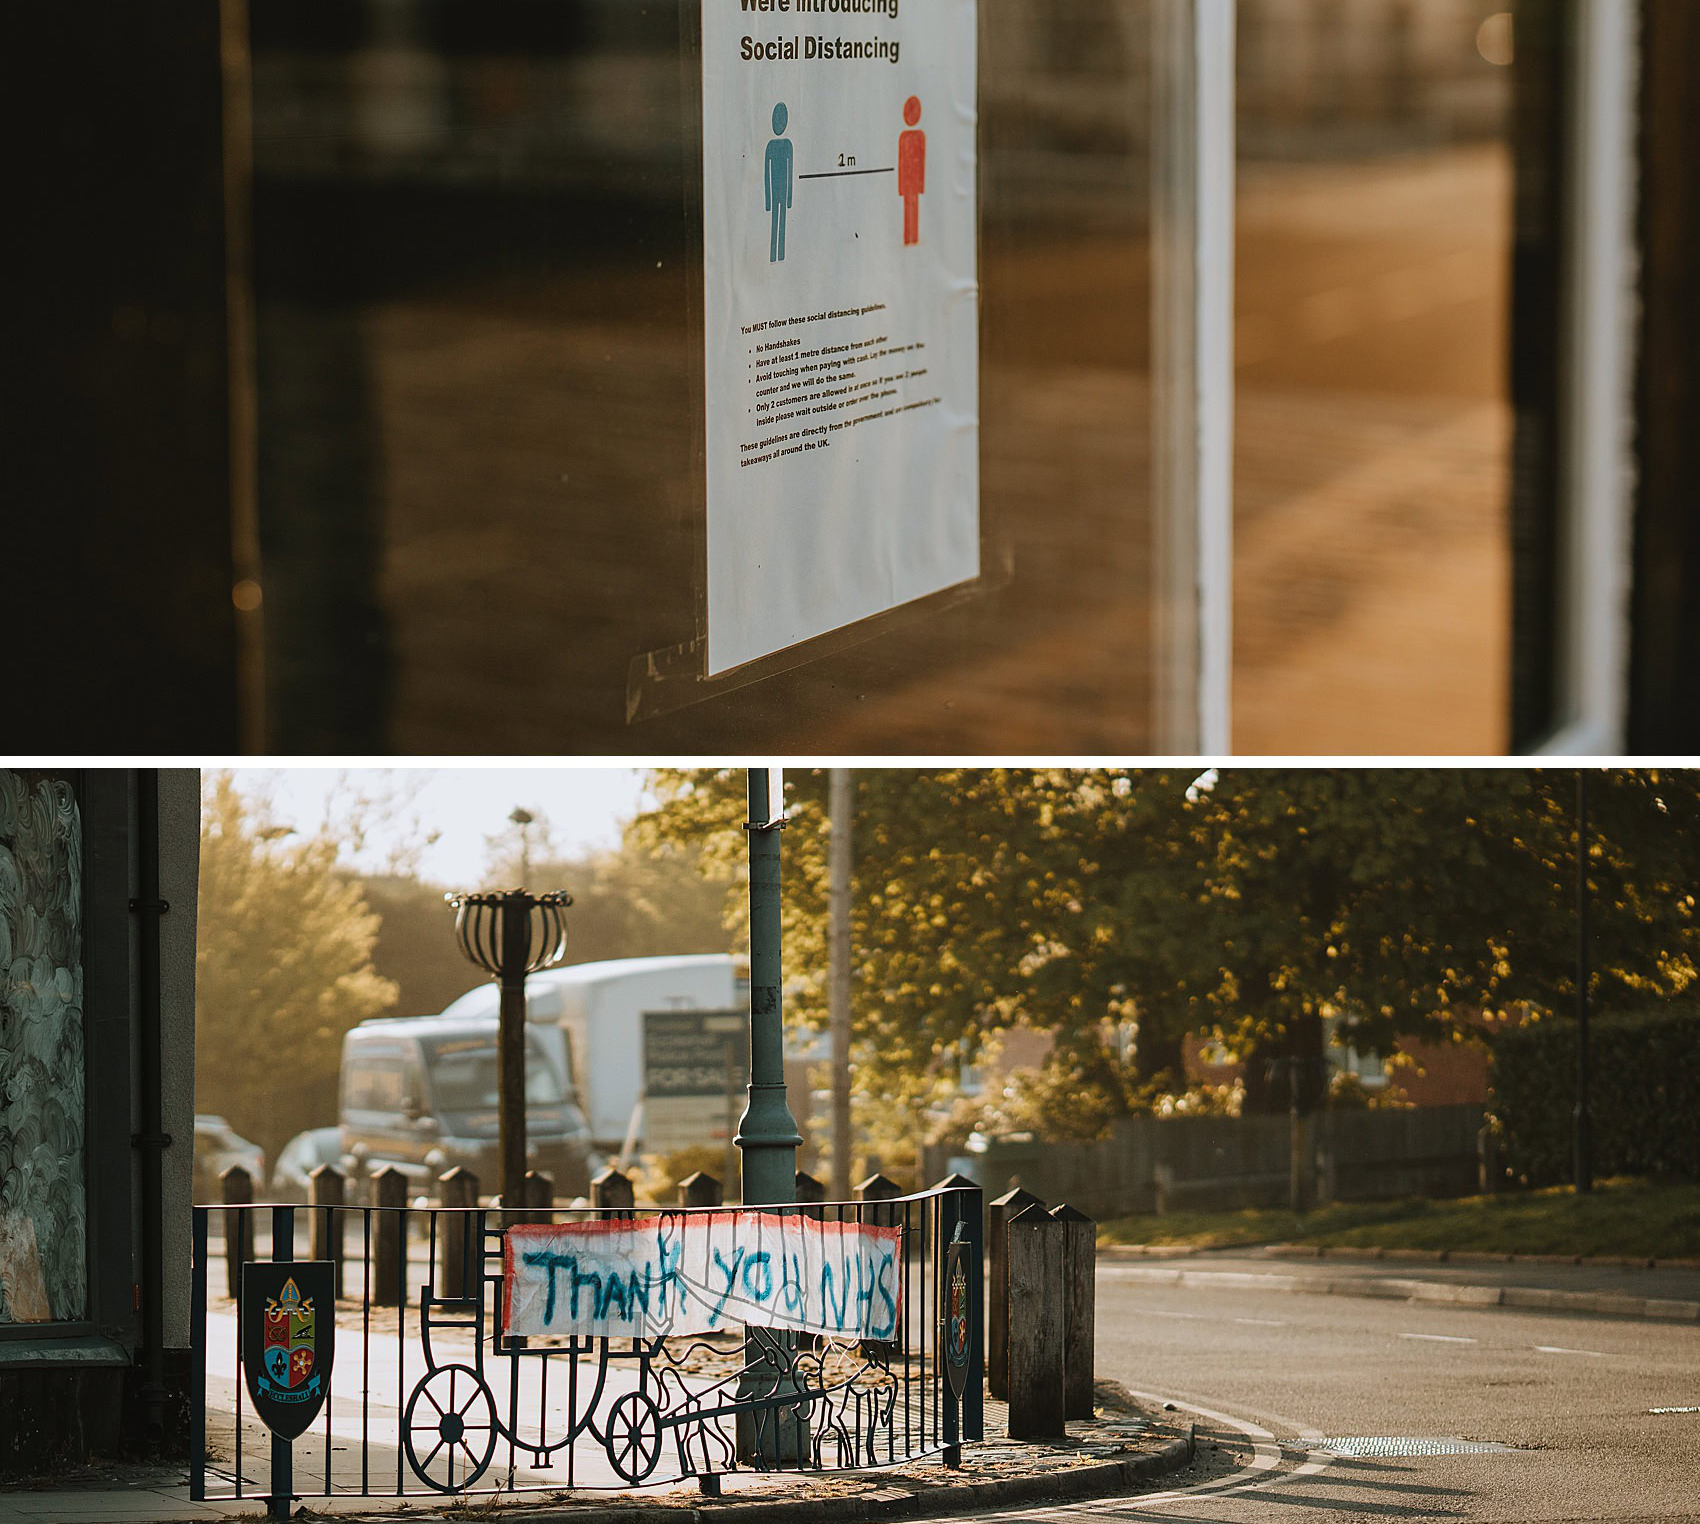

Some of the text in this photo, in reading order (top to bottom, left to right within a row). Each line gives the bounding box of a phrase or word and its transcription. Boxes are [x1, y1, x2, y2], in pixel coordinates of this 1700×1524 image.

[740, 35, 900, 64] Social Distancing
[741, 326, 752, 335] You
[752, 322, 768, 332] MUST
[768, 319, 787, 329] follow
[788, 317, 806, 326] these
[807, 312, 826, 321] social
[827, 308, 860, 319] distancing
[755, 359, 771, 368] Have
[771, 357, 779, 365] at
[779, 353, 794, 363] least
[800, 350, 820, 359] metre
[821, 344, 849, 355] distance
[850, 342, 863, 350] from
[864, 339, 875, 347] each
[875, 336, 888, 344] other
[756, 338, 801, 353] No Handshakes
[755, 372, 772, 383] Avoid
[773, 367, 799, 379] touching
[800, 364, 818, 373] when
[819, 360, 841, 372] paying
[843, 357, 856, 365] with
[879, 349, 887, 357] the
[755, 386, 779, 398] counter
[780, 382, 790, 392] and
[791, 381, 801, 389] we
[802, 377, 815, 387] will
[815, 376, 824, 385] do
[825, 374, 837, 383] the
[756, 402, 770, 413] Only
[771, 400, 775, 409] 2
[776, 394, 808, 407] customers
[809, 391, 821, 400] are
[821, 385, 847, 398] allowed
[854, 383, 859, 391] at
[859, 381, 871, 389] once
[884, 376, 894, 385] you
[756, 416, 774, 427] inside
[775, 410, 794, 424] please
[795, 407, 811, 417] wait
[812, 401, 837, 414] outside
[838, 401, 846, 409] or
[845, 397, 858, 407] order
[740, 441, 758, 453] These
[759, 434, 788, 449] guidelines
[789, 431, 800, 440] are
[801, 424, 828, 437] directly
[828, 422, 843, 432] from
[844, 419, 852, 428] the
[740, 453, 772, 468] takeaways
[780, 444, 803, 456] around
[804, 442, 816, 451] the
[817, 438, 830, 448] UK.
[821, 1252, 894, 1338] NHS
